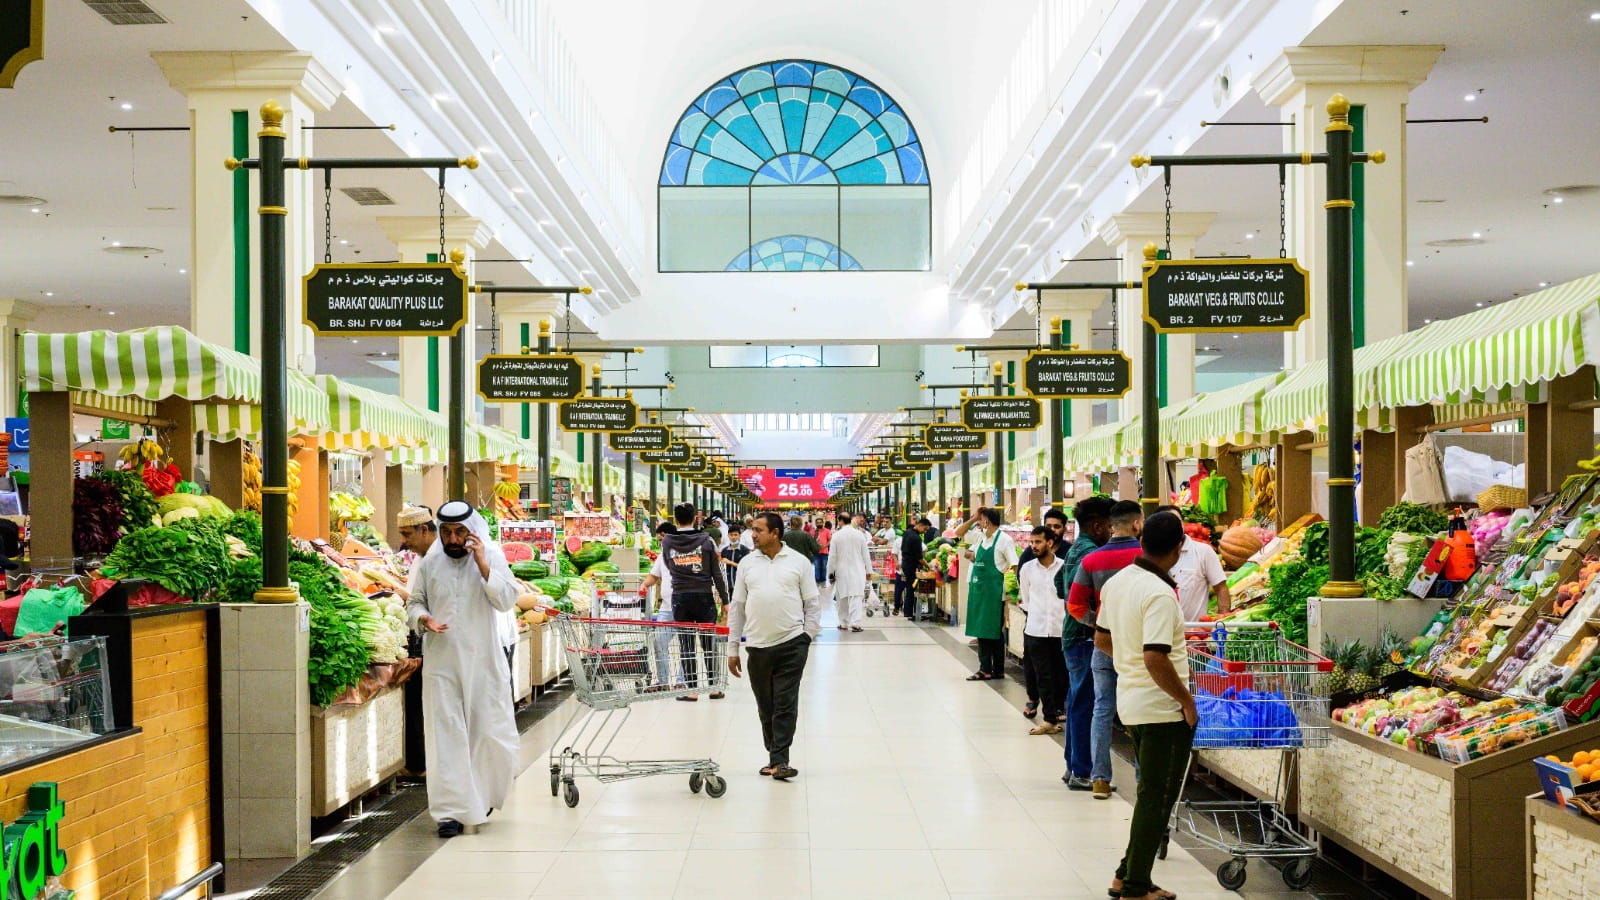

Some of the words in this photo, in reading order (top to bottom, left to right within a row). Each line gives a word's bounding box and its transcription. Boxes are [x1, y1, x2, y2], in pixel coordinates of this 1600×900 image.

[328, 276, 334, 285] م
[336, 276, 342, 285] م
[345, 273, 351, 284] ذ
[352, 274, 376, 286] بلاس
[416, 273, 444, 286] بركات
[1242, 270, 1264, 283] بركات
[1265, 268, 1284, 282] شركة
[328, 296, 367, 310] BARAKAT
[368, 296, 403, 310] QUALITY
[404, 296, 426, 310] PLUS
[428, 296, 444, 310] LLC
[1168, 293, 1204, 307] BARAKAT
[1229, 292, 1256, 306] FRUITS
[329, 319, 346, 328] BR.
[347, 319, 366, 328] SHJ
[370, 319, 384, 328] FV
[385, 319, 402, 328] 084
[1170, 316, 1186, 324] BR.
[1187, 316, 1194, 324] 2
[1210, 316, 1224, 324] FV
[1226, 315, 1243, 323] 107
[1038, 371, 1062, 382] BARAKAT
[1078, 371, 1096, 382] FRUITS
